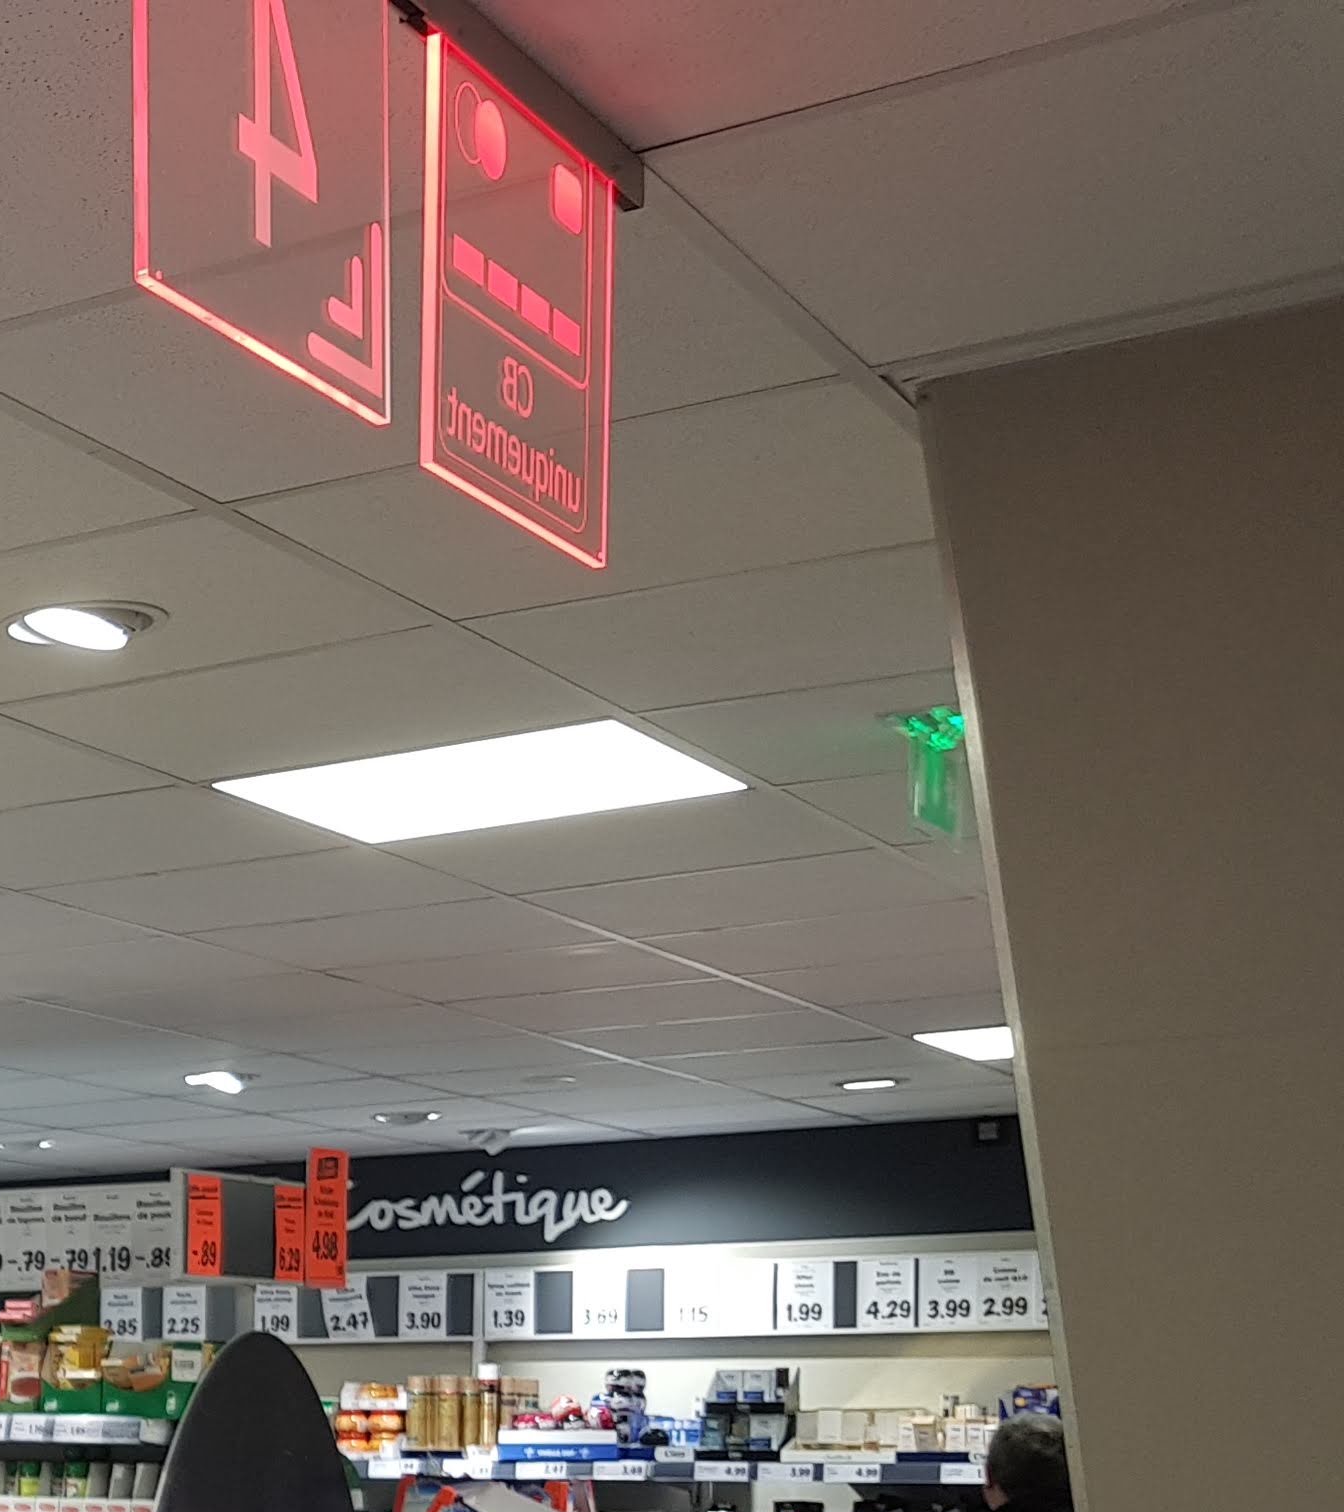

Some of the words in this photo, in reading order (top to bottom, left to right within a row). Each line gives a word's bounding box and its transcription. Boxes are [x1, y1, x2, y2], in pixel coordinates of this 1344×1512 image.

[347, 1170, 630, 1243] osmétique
[7, 1251, 45, 1271] -.79
[50, 1249, 88, 1270] -.79
[93, 1246, 130, 1272] 1.19
[786, 1303, 823, 1322] 1.99
[866, 1300, 912, 1320] 4.29
[927, 1299, 971, 1318] 3.99
[983, 1297, 1028, 1317] 2.99
[493, 1309, 525, 1328] 1.39
